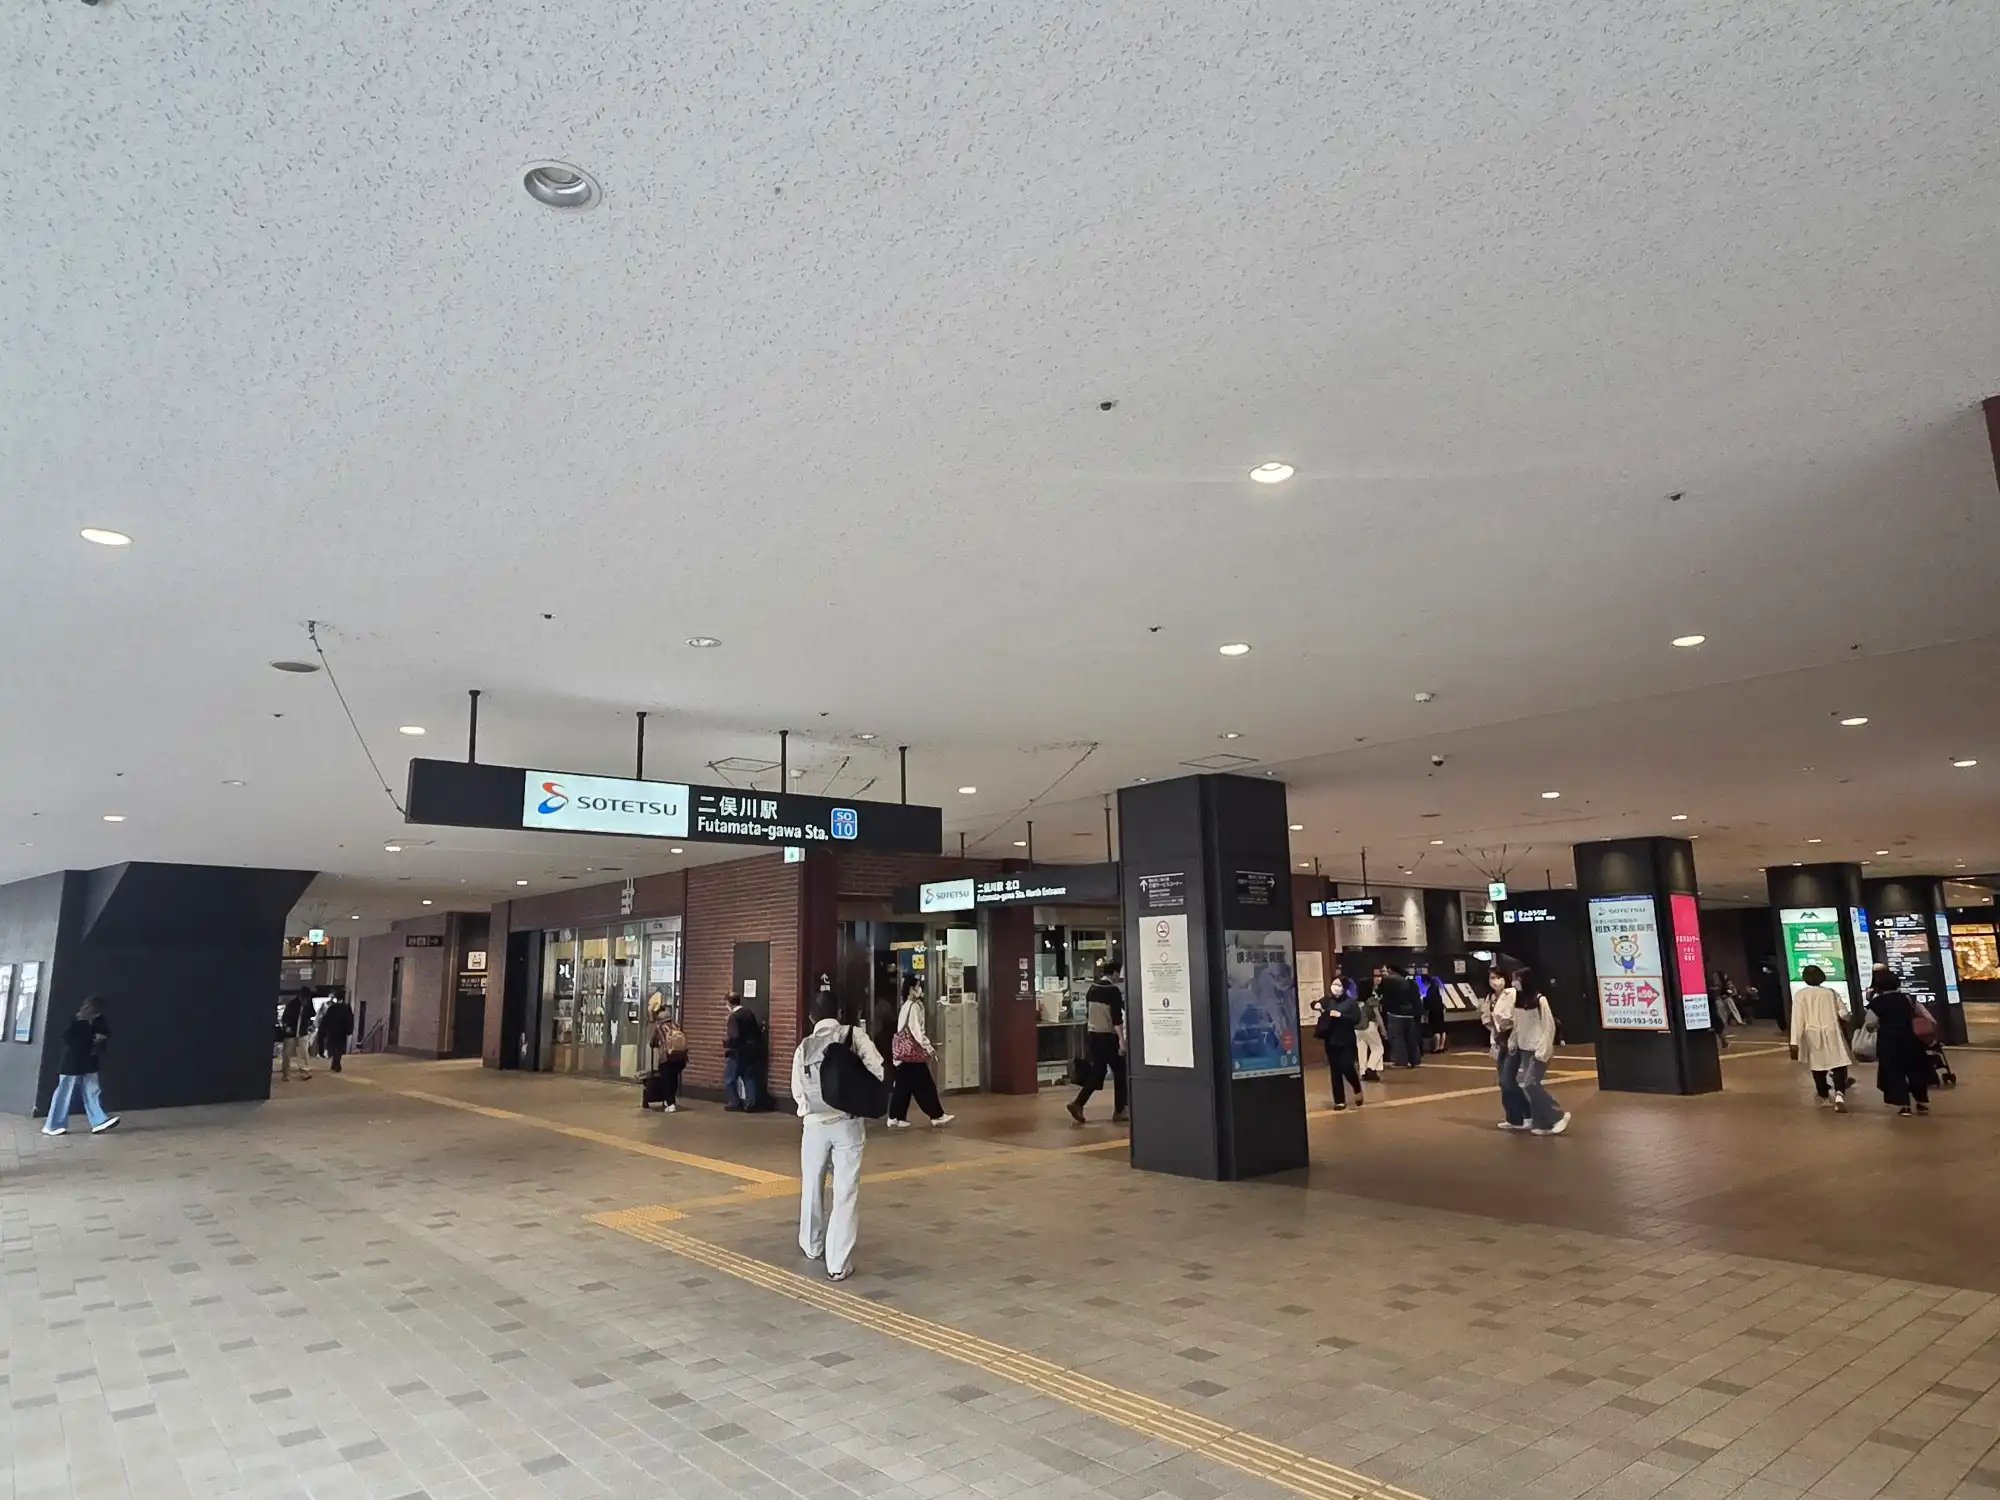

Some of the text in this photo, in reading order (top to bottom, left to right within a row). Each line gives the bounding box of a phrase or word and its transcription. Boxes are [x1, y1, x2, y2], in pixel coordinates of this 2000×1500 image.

[576, 796, 678, 817] SOTETSU
[698, 796, 778, 819] 二俣川駅
[836, 811, 852, 821] SO
[698, 816, 829, 840] Futamata-gawa Sta.
[836, 823, 853, 836] 10
[936, 889, 970, 900] SOTETSU
[1604, 981, 1636, 992] この先
[1605, 992, 1636, 1007] 右折
